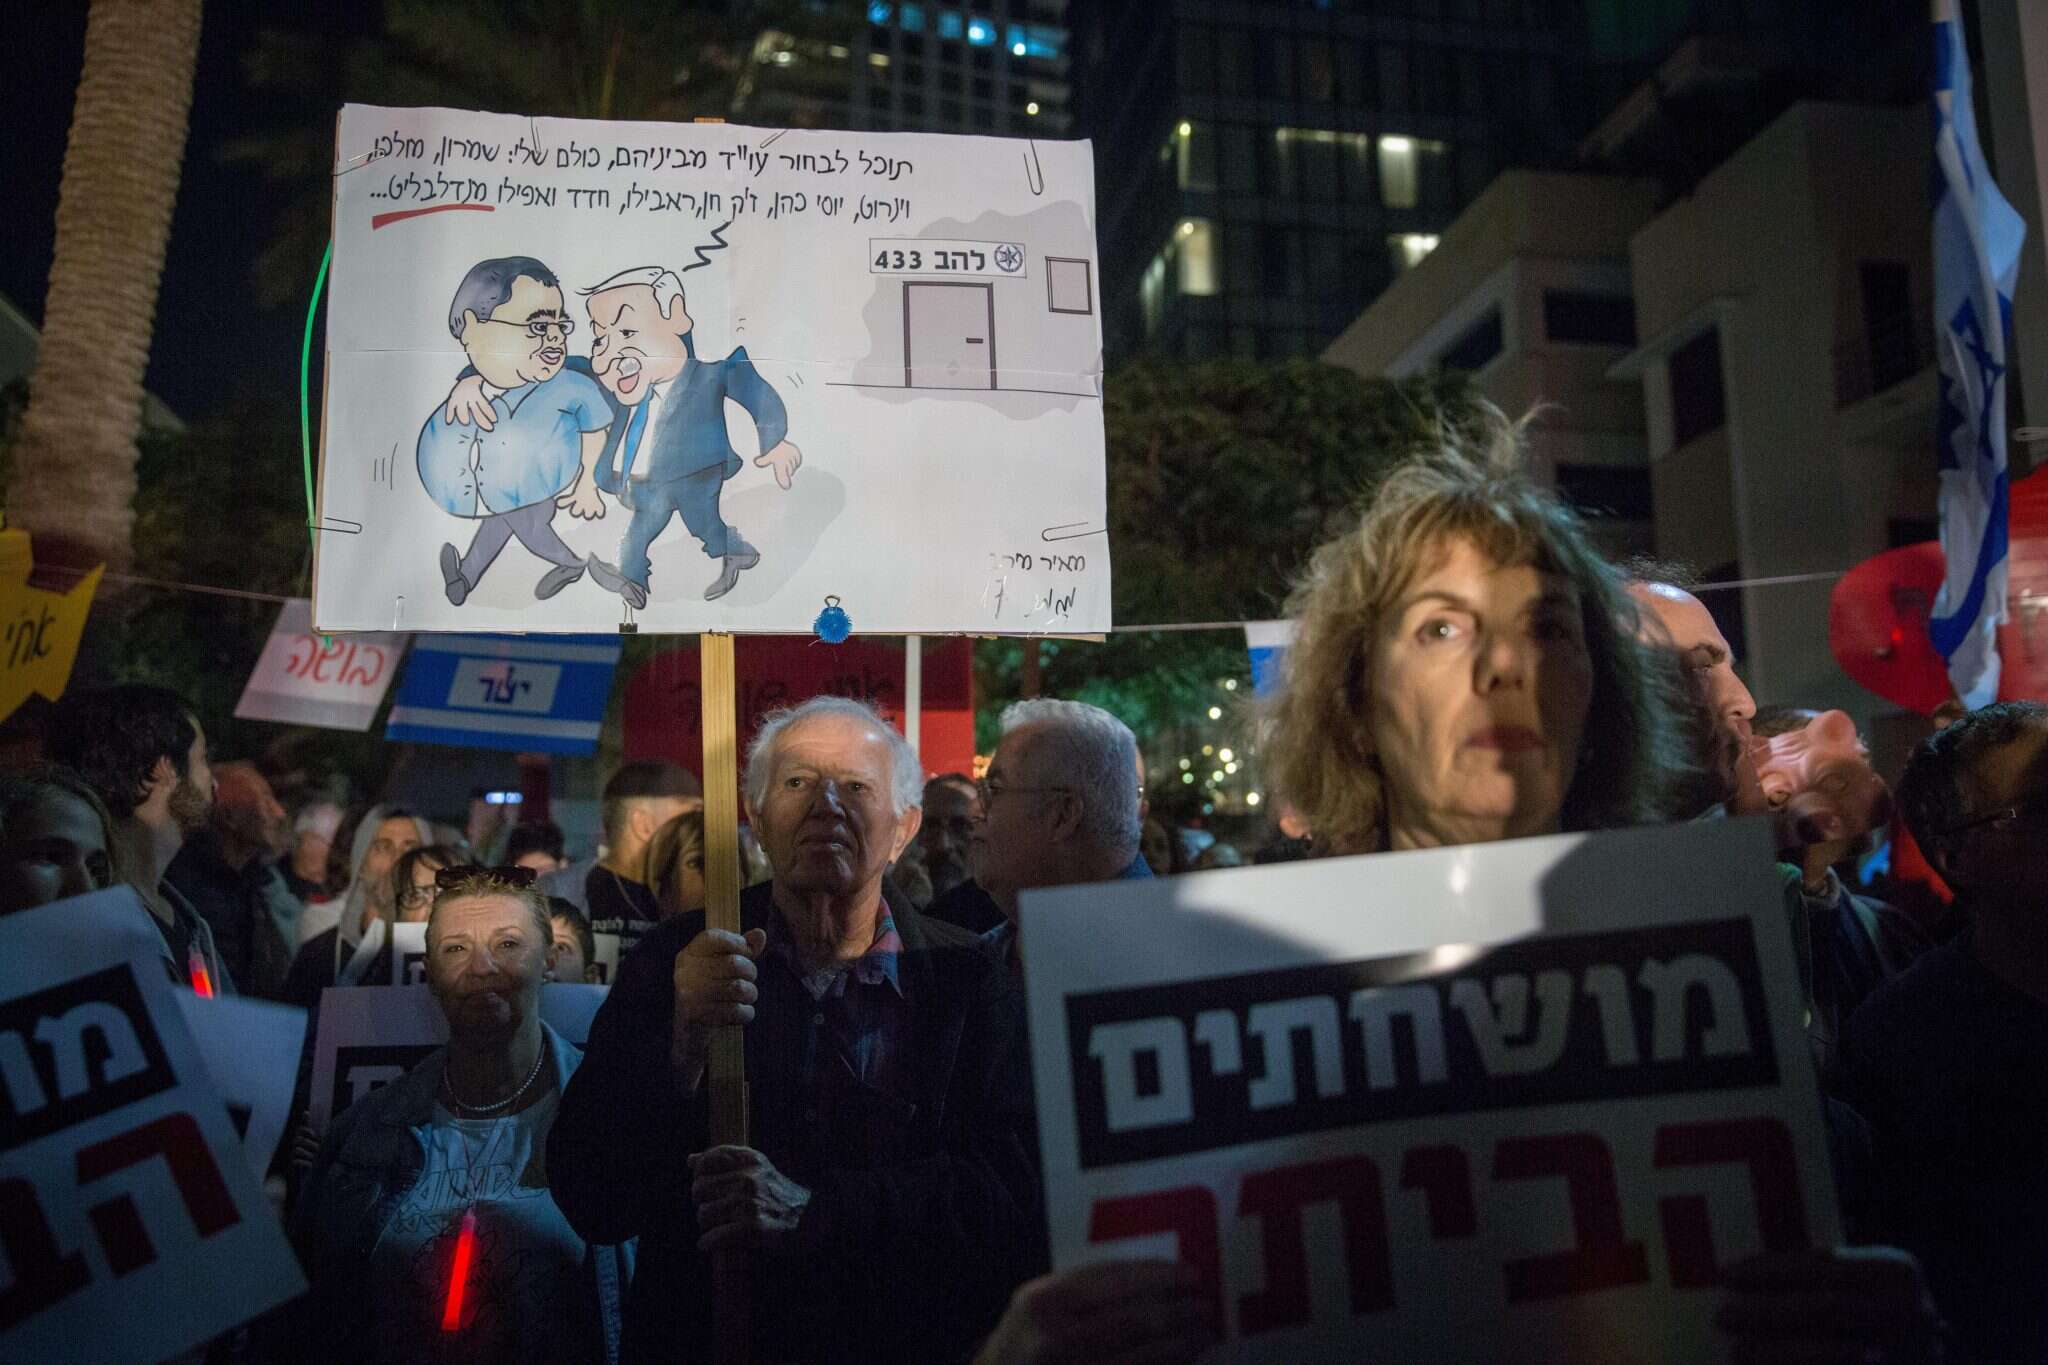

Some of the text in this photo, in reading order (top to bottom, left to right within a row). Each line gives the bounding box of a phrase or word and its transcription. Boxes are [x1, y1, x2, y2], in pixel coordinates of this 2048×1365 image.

[432, 135, 501, 167] שמרון,
[507, 136, 549, 166] שלי:
[556, 140, 601, 168] כולם
[607, 146, 707, 172] מביניהם,
[778, 148, 849, 174] לבחור
[858, 149, 914, 181] תוכל
[497, 175, 557, 207] ואפילו
[566, 188, 610, 209] חדד
[766, 191, 808, 220] כהן,
[816, 194, 845, 217] יוסי
[874, 249, 986, 271] להב 433
[1087, 953, 1754, 1133] מושחתים
